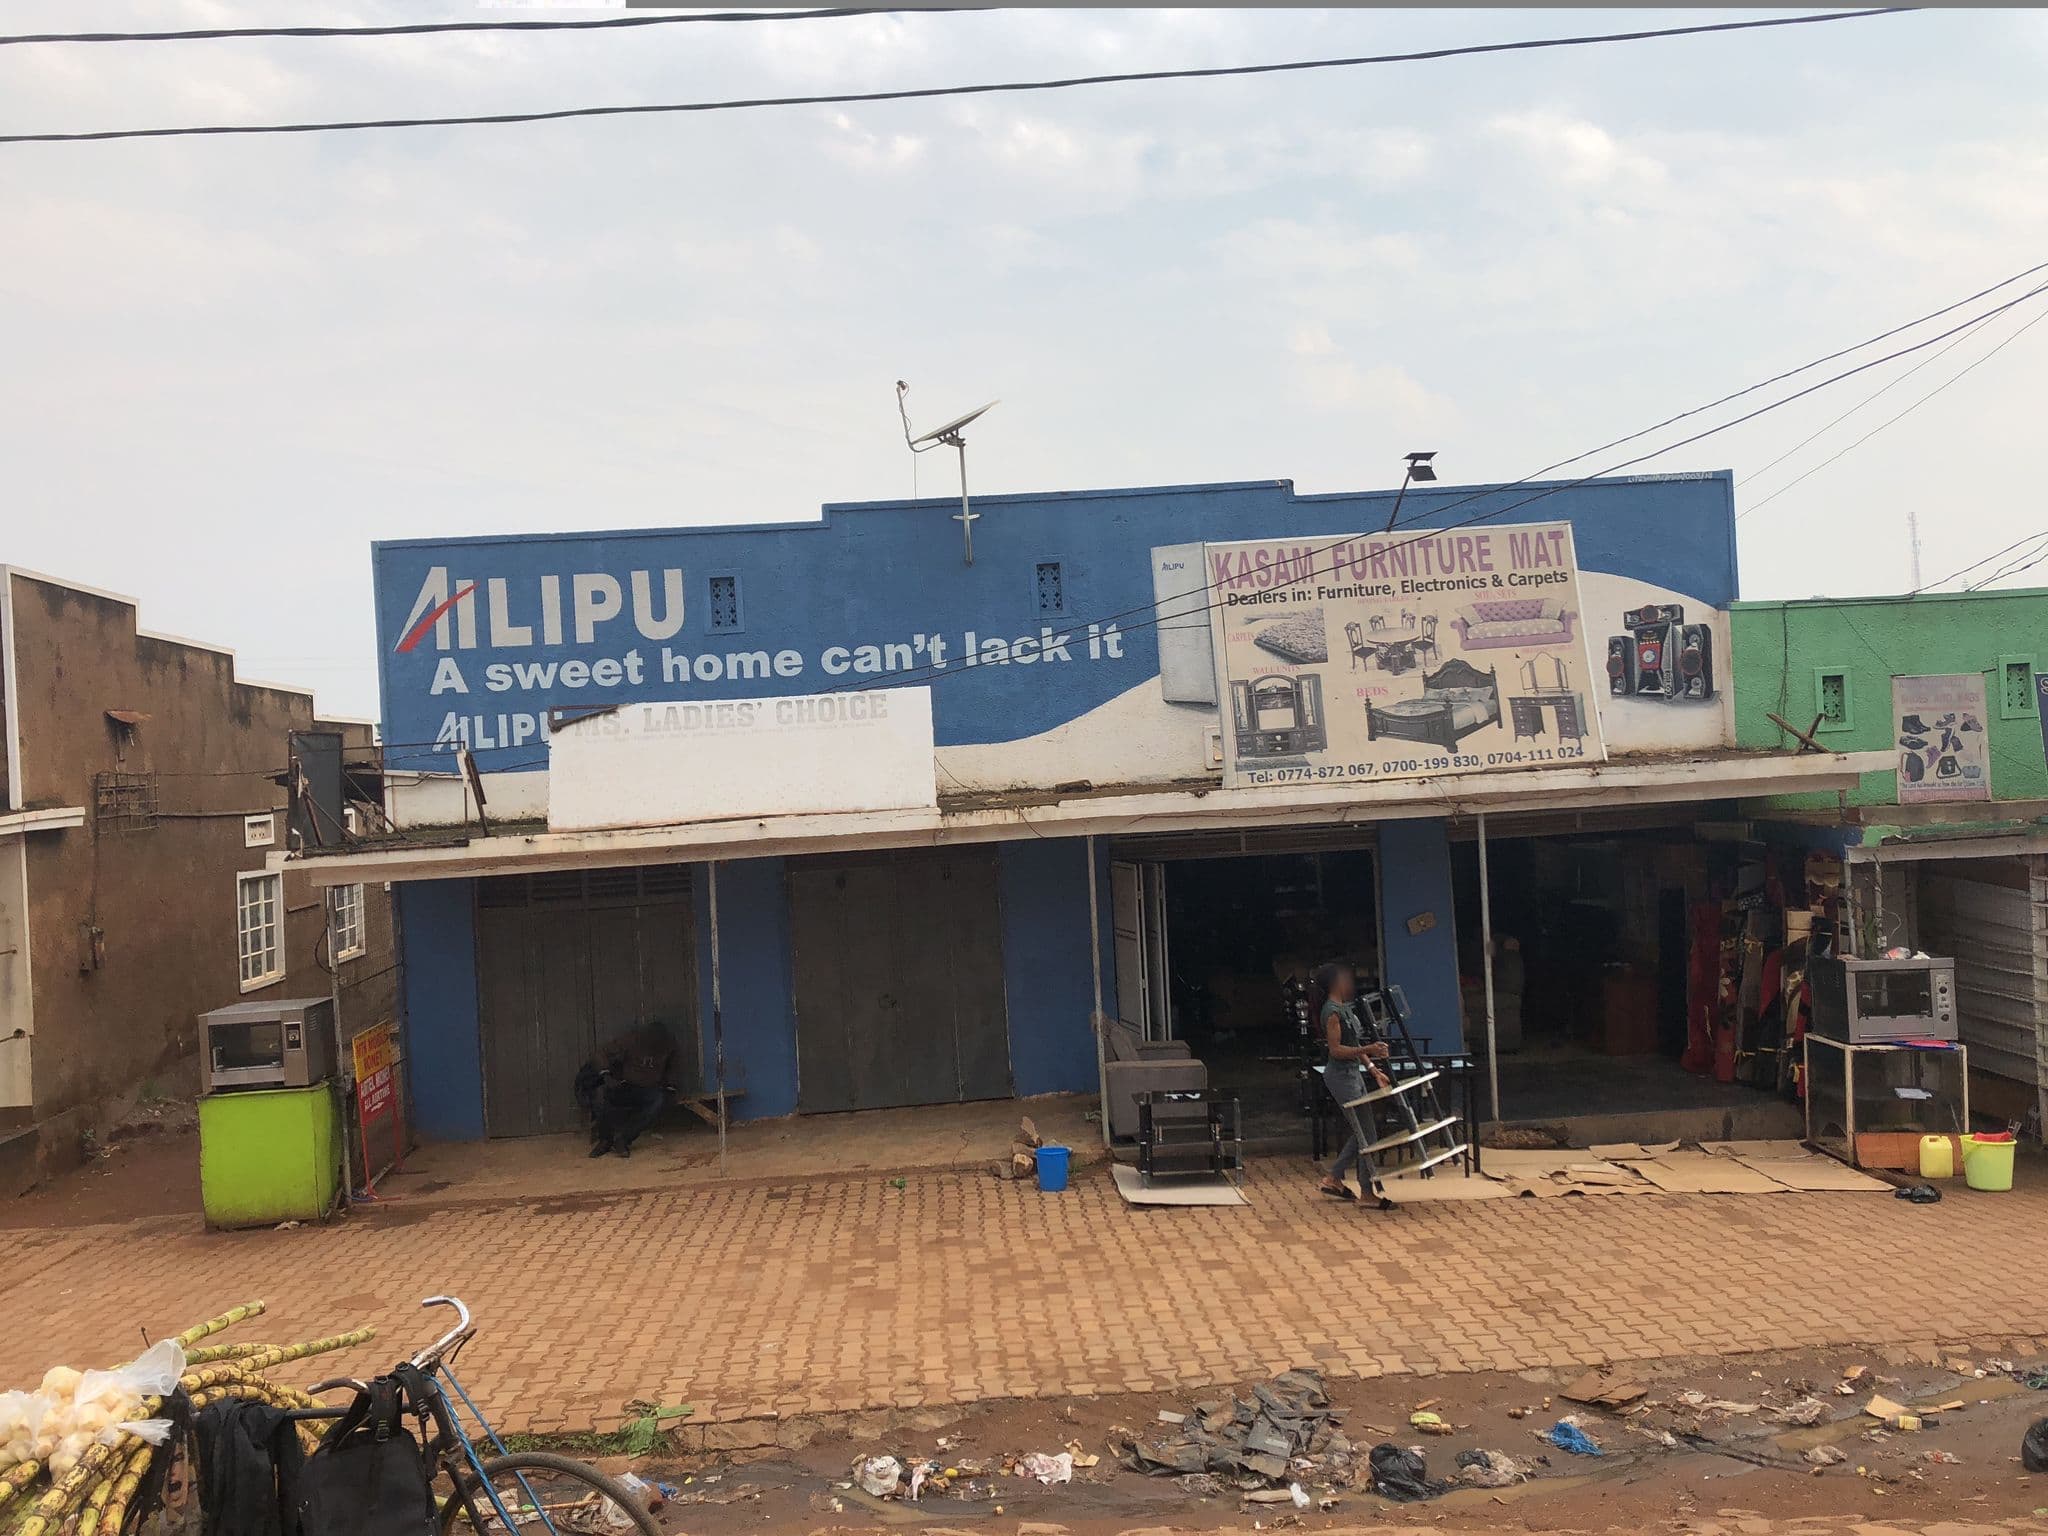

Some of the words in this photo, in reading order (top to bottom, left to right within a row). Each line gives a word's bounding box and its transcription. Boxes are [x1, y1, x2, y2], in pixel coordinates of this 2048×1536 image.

[1215, 547, 1315, 590] KASAM
[1332, 535, 1494, 582] FURNITURE
[1509, 530, 1564, 569] MAT
[1228, 590, 1288, 607] Dealers
[1292, 588, 1312, 602] in:
[1318, 583, 1396, 599] Furniture,
[1401, 575, 1487, 593] Electronics
[1492, 574, 1504, 587] &
[1508, 570, 1569, 588] Carpets
[394, 567, 686, 653] AILIPU
[430, 657, 469, 695] A
[485, 648, 643, 692] sweet
[661, 647, 804, 683] home
[820, 634, 946, 676] can't
[965, 627, 1072, 666] lack
[1088, 623, 1124, 661] it
[1356, 686, 1389, 697] BEDS
[642, 701, 763, 733] LADIES'
[776, 693, 888, 725] CHOICE
[1248, 771, 1273, 784] Tel:
[1277, 765, 1344, 781] 0774-872
[1348, 763, 1379, 777] 067,
[1383, 757, 1449, 774] 0700-199
[1453, 755, 1484, 768] 830,
[1487, 749, 1553, 765] 0704-111
[1557, 746, 1584, 759] 024
